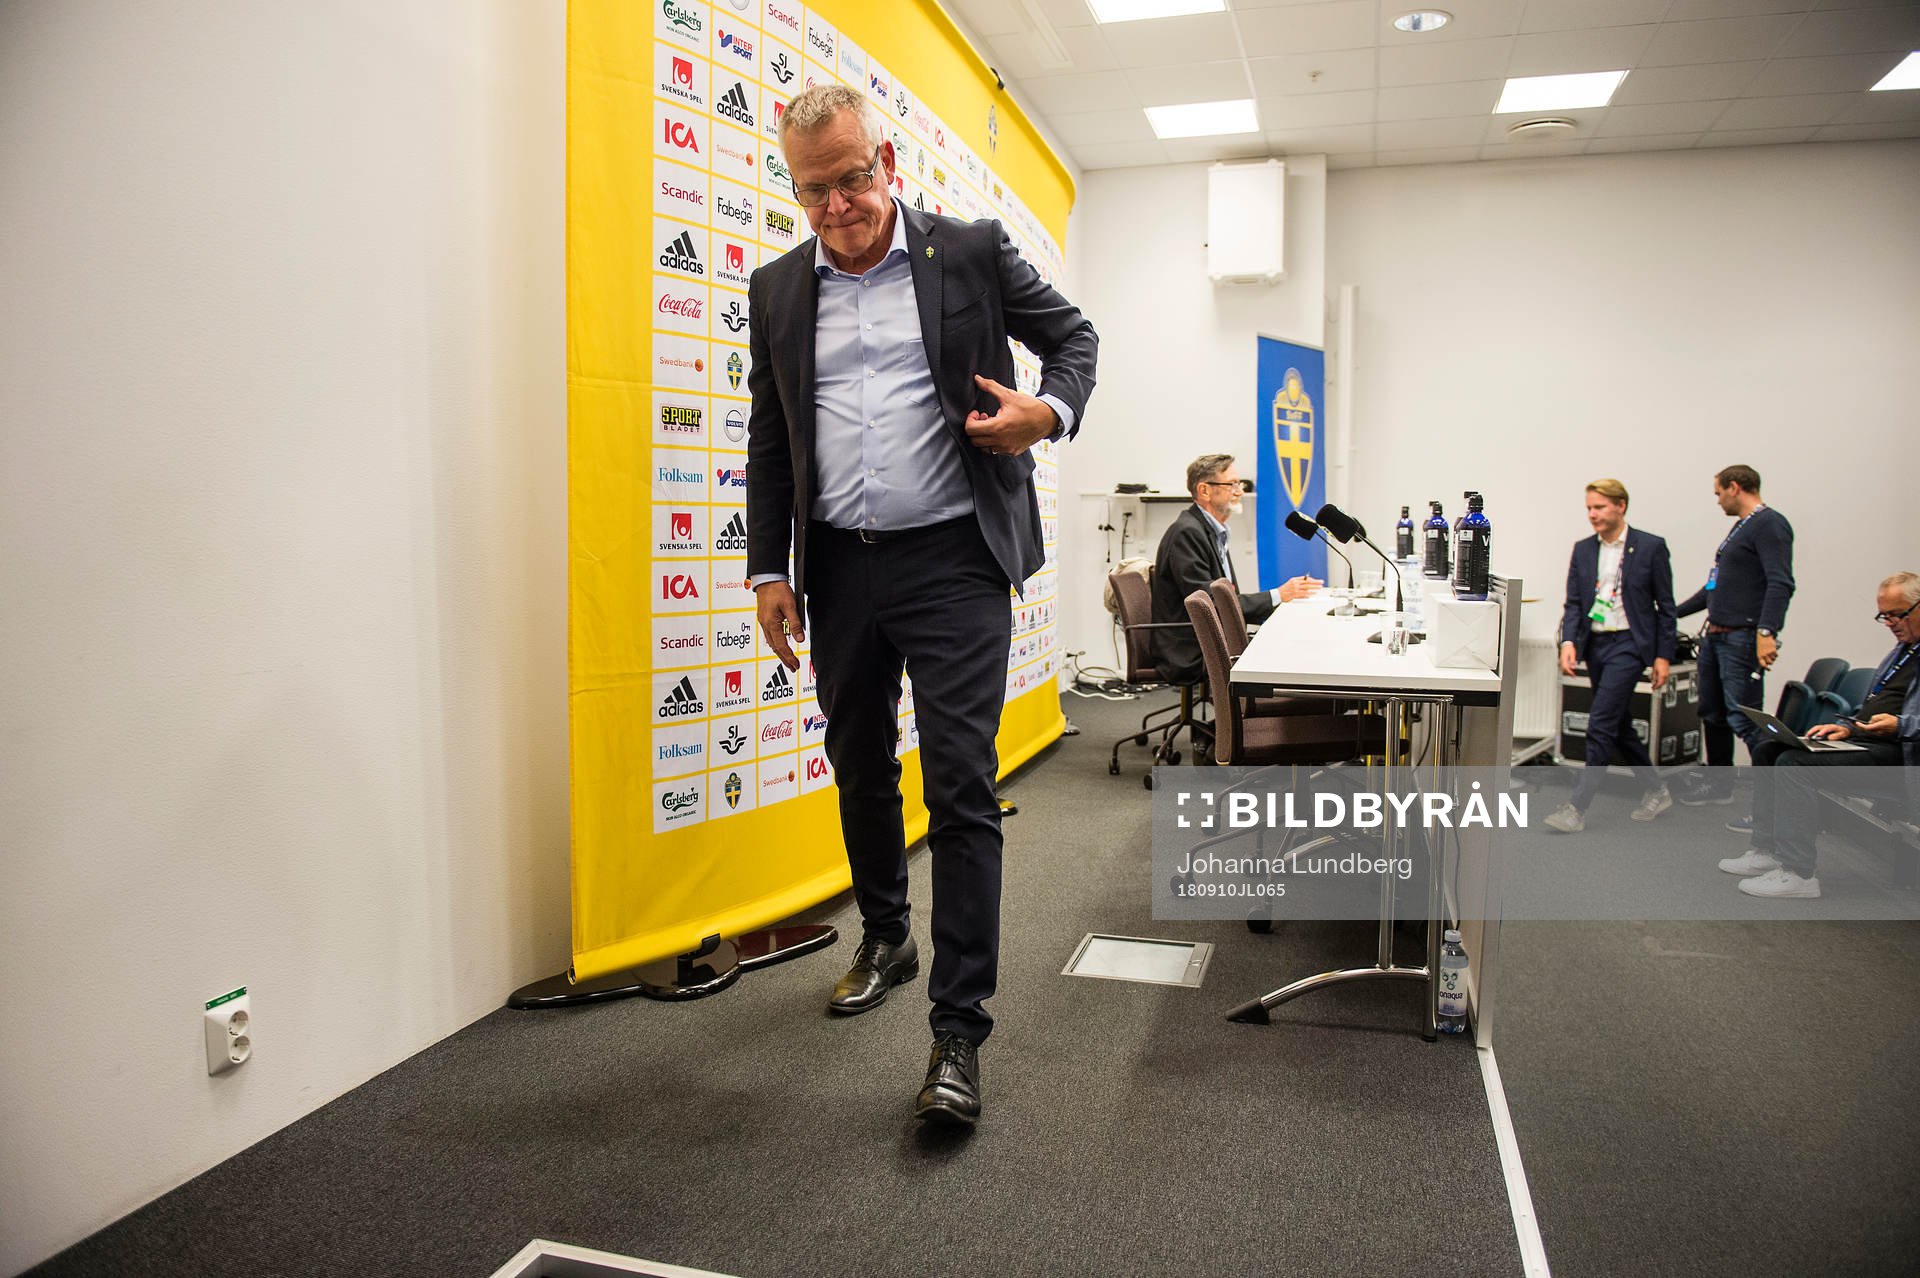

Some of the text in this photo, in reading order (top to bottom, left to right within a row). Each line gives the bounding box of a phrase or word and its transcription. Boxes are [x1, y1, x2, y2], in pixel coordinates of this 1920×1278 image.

[663, 0, 702, 31] Carlsberg
[768, 4, 799, 31] Scandic
[733, 36, 752, 52] INTER
[809, 28, 833, 57] Fabege
[733, 45, 752, 61] SPORT
[779, 53, 788, 68] SJ
[662, 84, 702, 104] SVENSKA SPEL
[717, 102, 754, 126] adidas
[665, 118, 699, 153] ICA
[766, 126, 778, 134] SVEN
[662, 182, 704, 205] Scandic
[718, 197, 752, 225] Fabege
[766, 209, 794, 234] SPORT
[768, 228, 793, 240] BLADET
[660, 254, 703, 275] adidas
[717, 271, 750, 285] SVENSKA SPE
[730, 302, 740, 317] SJ
[660, 357, 694, 368] Swedbank
[662, 407, 701, 426] SPORT
[659, 466, 703, 483] Folksam
[731, 479, 746, 487] SPOR
[716, 536, 746, 550] adida
[663, 574, 699, 600] ICA
[661, 634, 703, 649] Scandic
[717, 631, 750, 649] Fabege
[762, 685, 793, 701] adidas
[659, 701, 703, 718] adidas
[716, 700, 738, 708] SVENSKA
[729, 725, 738, 738] SJ
[659, 744, 702, 760] Folksam
[807, 756, 828, 780] ICA
[662, 791, 698, 811] Carlsberg
